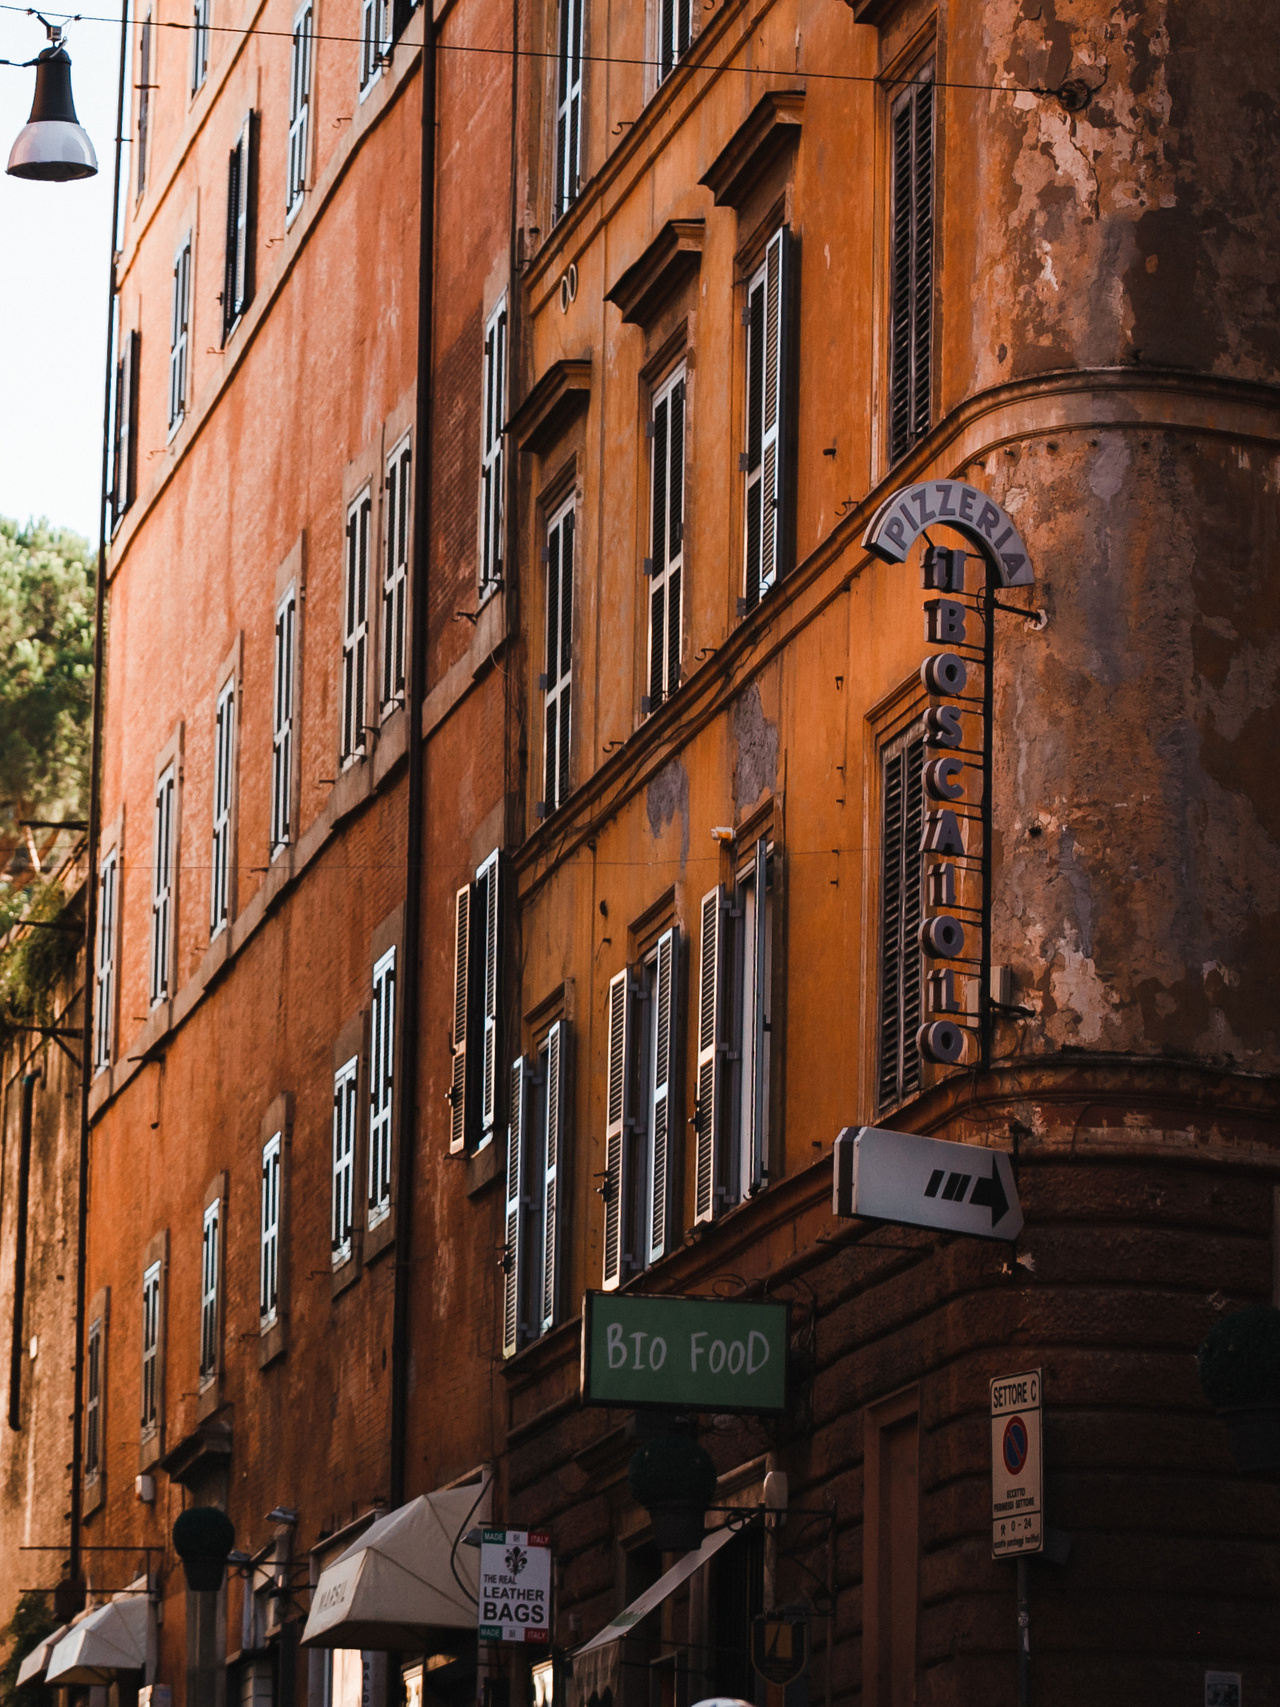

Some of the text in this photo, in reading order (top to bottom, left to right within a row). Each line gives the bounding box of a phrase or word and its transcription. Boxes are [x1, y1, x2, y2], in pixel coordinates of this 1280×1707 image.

[884, 485, 1026, 579] PIZZERIA
[917, 598, 967, 1063] BOSCAIOLO
[607, 1323, 770, 1375] BIO FOOD
[993, 1380, 1037, 1409] SETTORE C
[1015, 1497, 1034, 1509] SETTORE
[1011, 1520, 1016, 1532] 0
[1023, 1517, 1032, 1530] 24
[484, 1531, 504, 1542] MADE
[531, 1535, 550, 1545] ITALY
[483, 1574, 517, 1585] THE REAL
[483, 1586, 544, 1602] LEATHER
[483, 1602, 544, 1624] BAGS
[480, 1628, 500, 1638] MADE
[527, 1630, 547, 1640] ITALY
